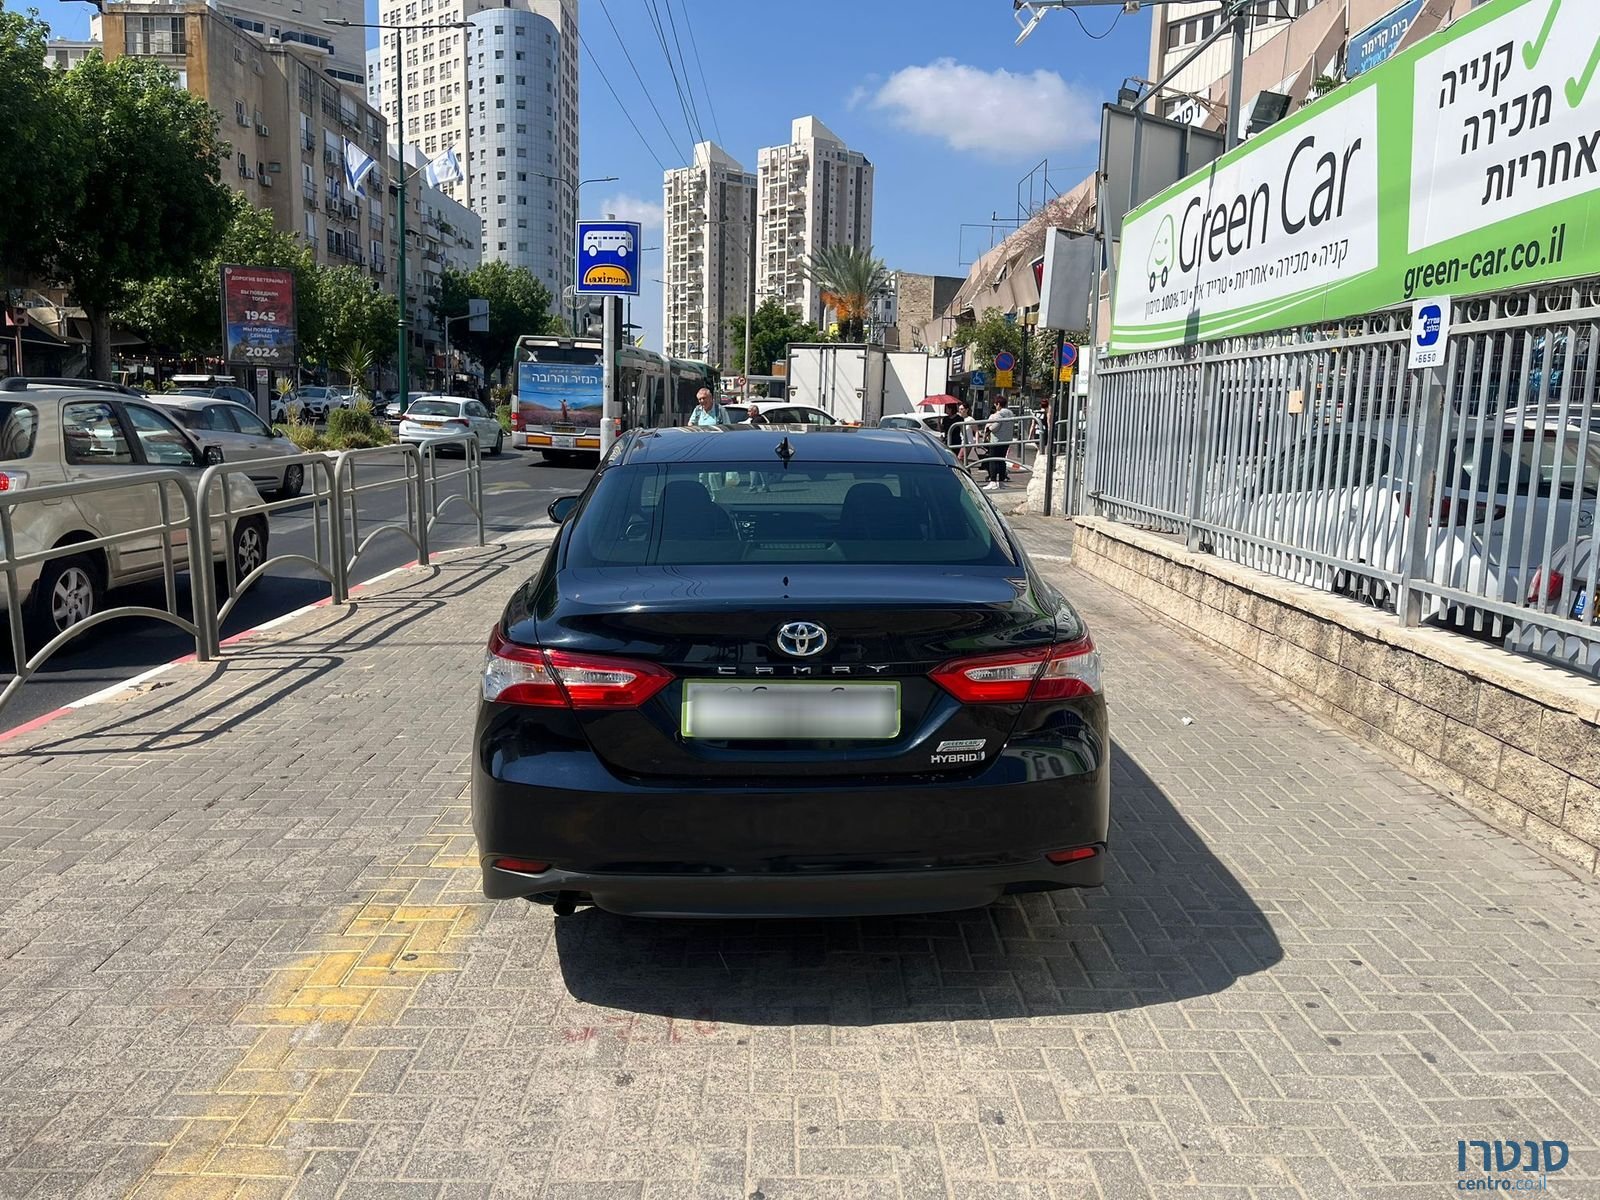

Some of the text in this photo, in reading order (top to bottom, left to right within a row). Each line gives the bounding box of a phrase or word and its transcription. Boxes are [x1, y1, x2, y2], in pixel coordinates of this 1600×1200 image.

[1391, 18, 1409, 39] בית
[1361, 29, 1389, 57] קדימה
[1438, 40, 1514, 109] קנייה
[1460, 84, 1552, 155] מכירה
[1481, 129, 1600, 206] אחריות
[1179, 135, 1362, 273] Green Car
[1275, 251, 1309, 278] מכירה
[1319, 239, 1349, 269] קניה
[1403, 223, 1566, 299] green-car.co.il
[1234, 263, 1268, 291] אחריות
[244, 310, 276, 321] 1945
[1161, 292, 1179, 312] 100%
[246, 347, 279, 358] 2024
[531, 373, 598, 384] הנזיר והרובה
[717, 664, 890, 675] CAMRY
[930, 753, 977, 764] HYBRID
